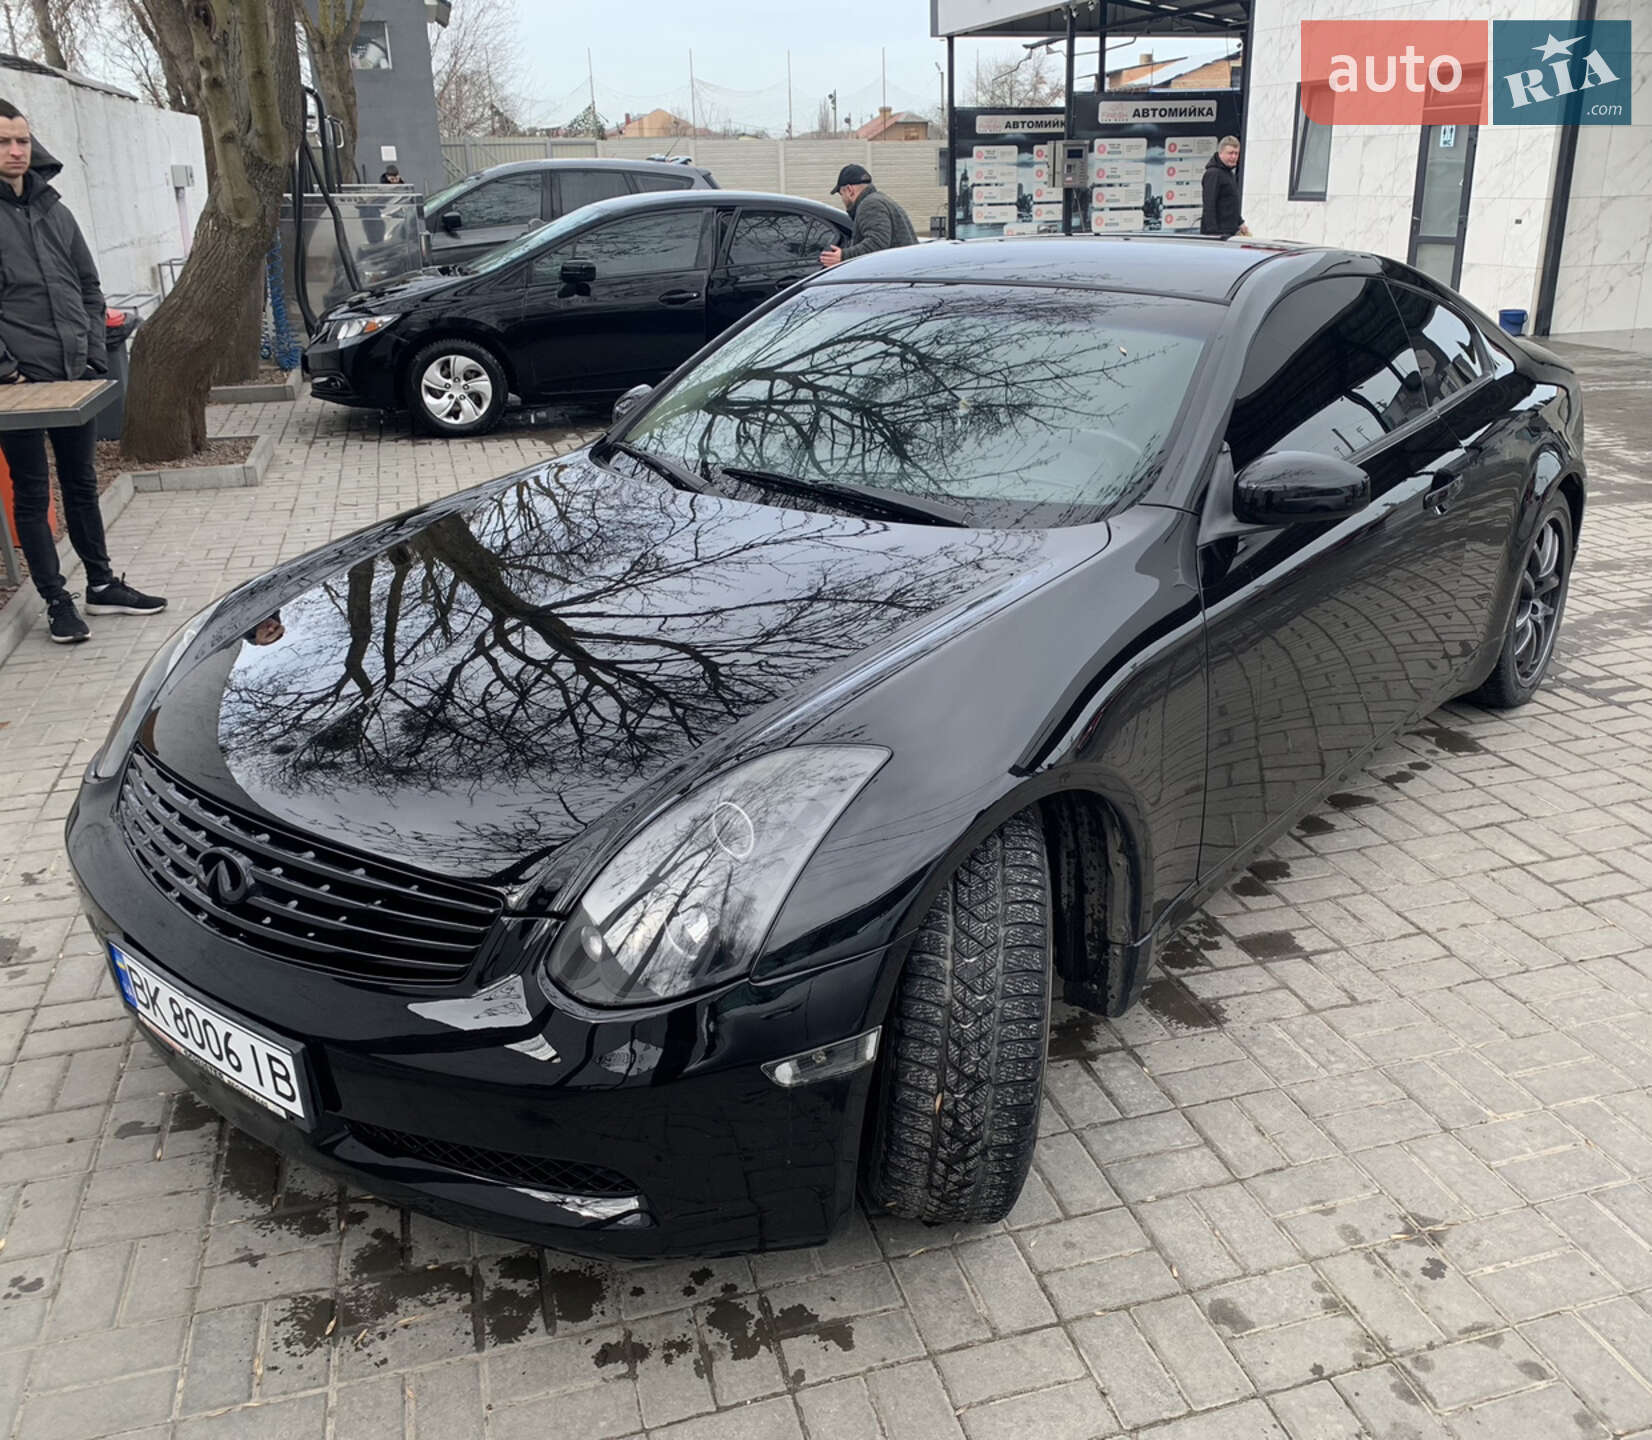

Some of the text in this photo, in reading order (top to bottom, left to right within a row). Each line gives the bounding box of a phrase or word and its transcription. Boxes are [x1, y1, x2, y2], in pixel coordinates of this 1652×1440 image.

[1132, 104, 1214, 118] АВТОМИЙКА
[1004, 118, 1065, 129] АВТОМИЙК
[127, 965, 169, 1027] BK
[169, 997, 242, 1073] 8006
[250, 1044, 297, 1103] IB
